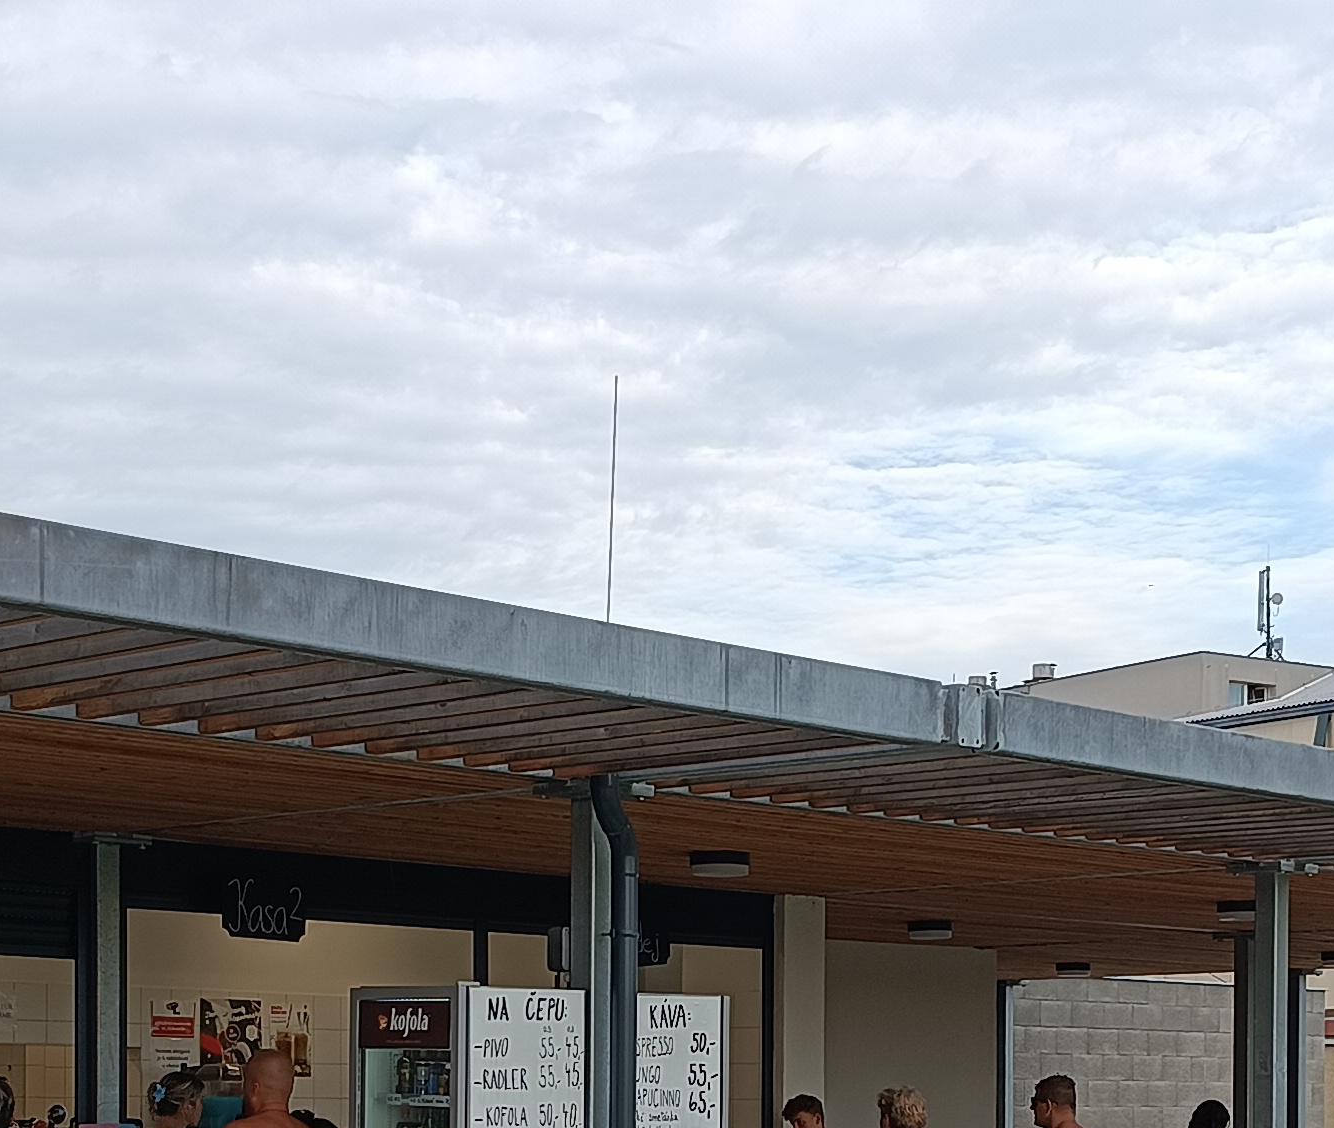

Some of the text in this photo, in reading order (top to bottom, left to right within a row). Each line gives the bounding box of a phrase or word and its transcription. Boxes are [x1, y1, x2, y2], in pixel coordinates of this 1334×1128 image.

[228, 877, 303, 935] Kasa 2
[487, 992, 568, 1021] NA ČEPU:
[649, 999, 692, 1029] KÁVA:
[389, 1007, 430, 1038] kofola
[635, 1033, 716, 1057] SPRESSO 50,-
[688, 1064, 718, 1091] 55,-
[636, 1088, 716, 1119] APUCINNO 65,-
